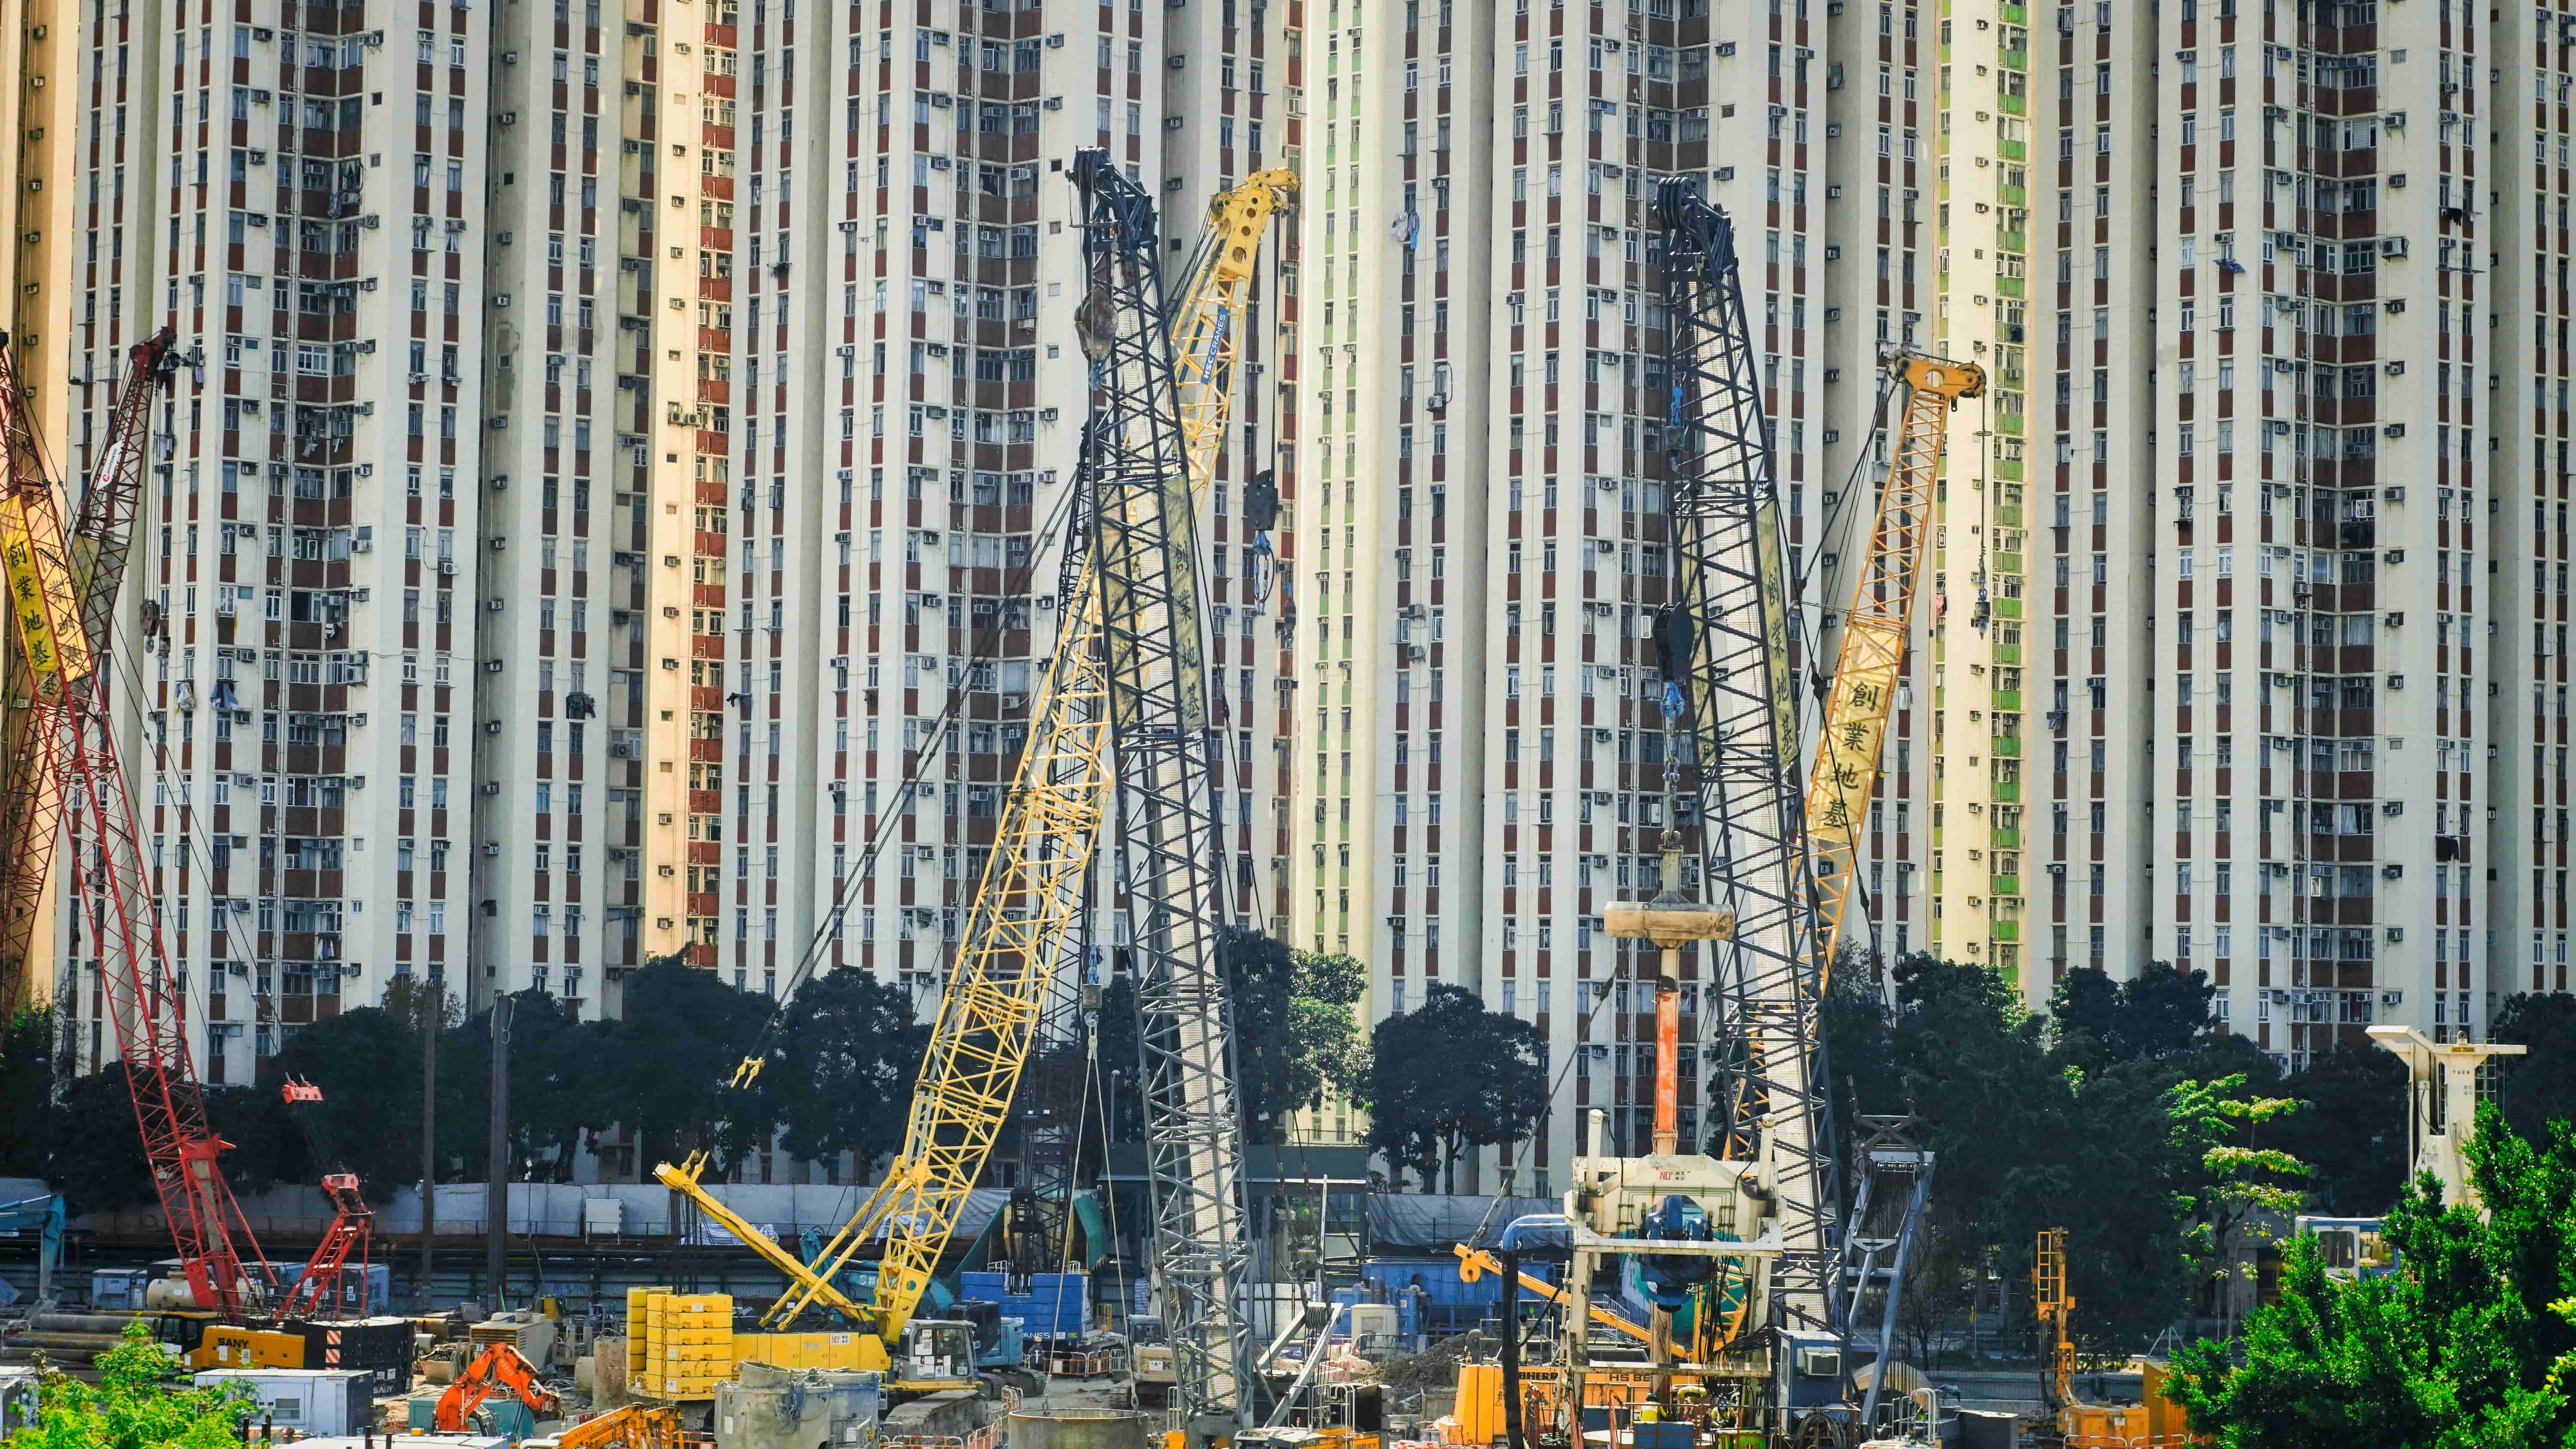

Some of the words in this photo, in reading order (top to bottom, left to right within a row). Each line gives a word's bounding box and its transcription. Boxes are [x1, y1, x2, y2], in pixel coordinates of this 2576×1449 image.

[1203, 356, 1214, 379] HSC
[1210, 314, 1226, 355] CRANES
[9, 541, 51, 667] 創業地基
[1176, 541, 1200, 719] 創業地基
[1768, 567, 1793, 756] 創業地基
[1819, 681, 1880, 829] 創業地基
[218, 1337, 249, 1348] SANY
[1518, 1372, 1558, 1380] BHERR
